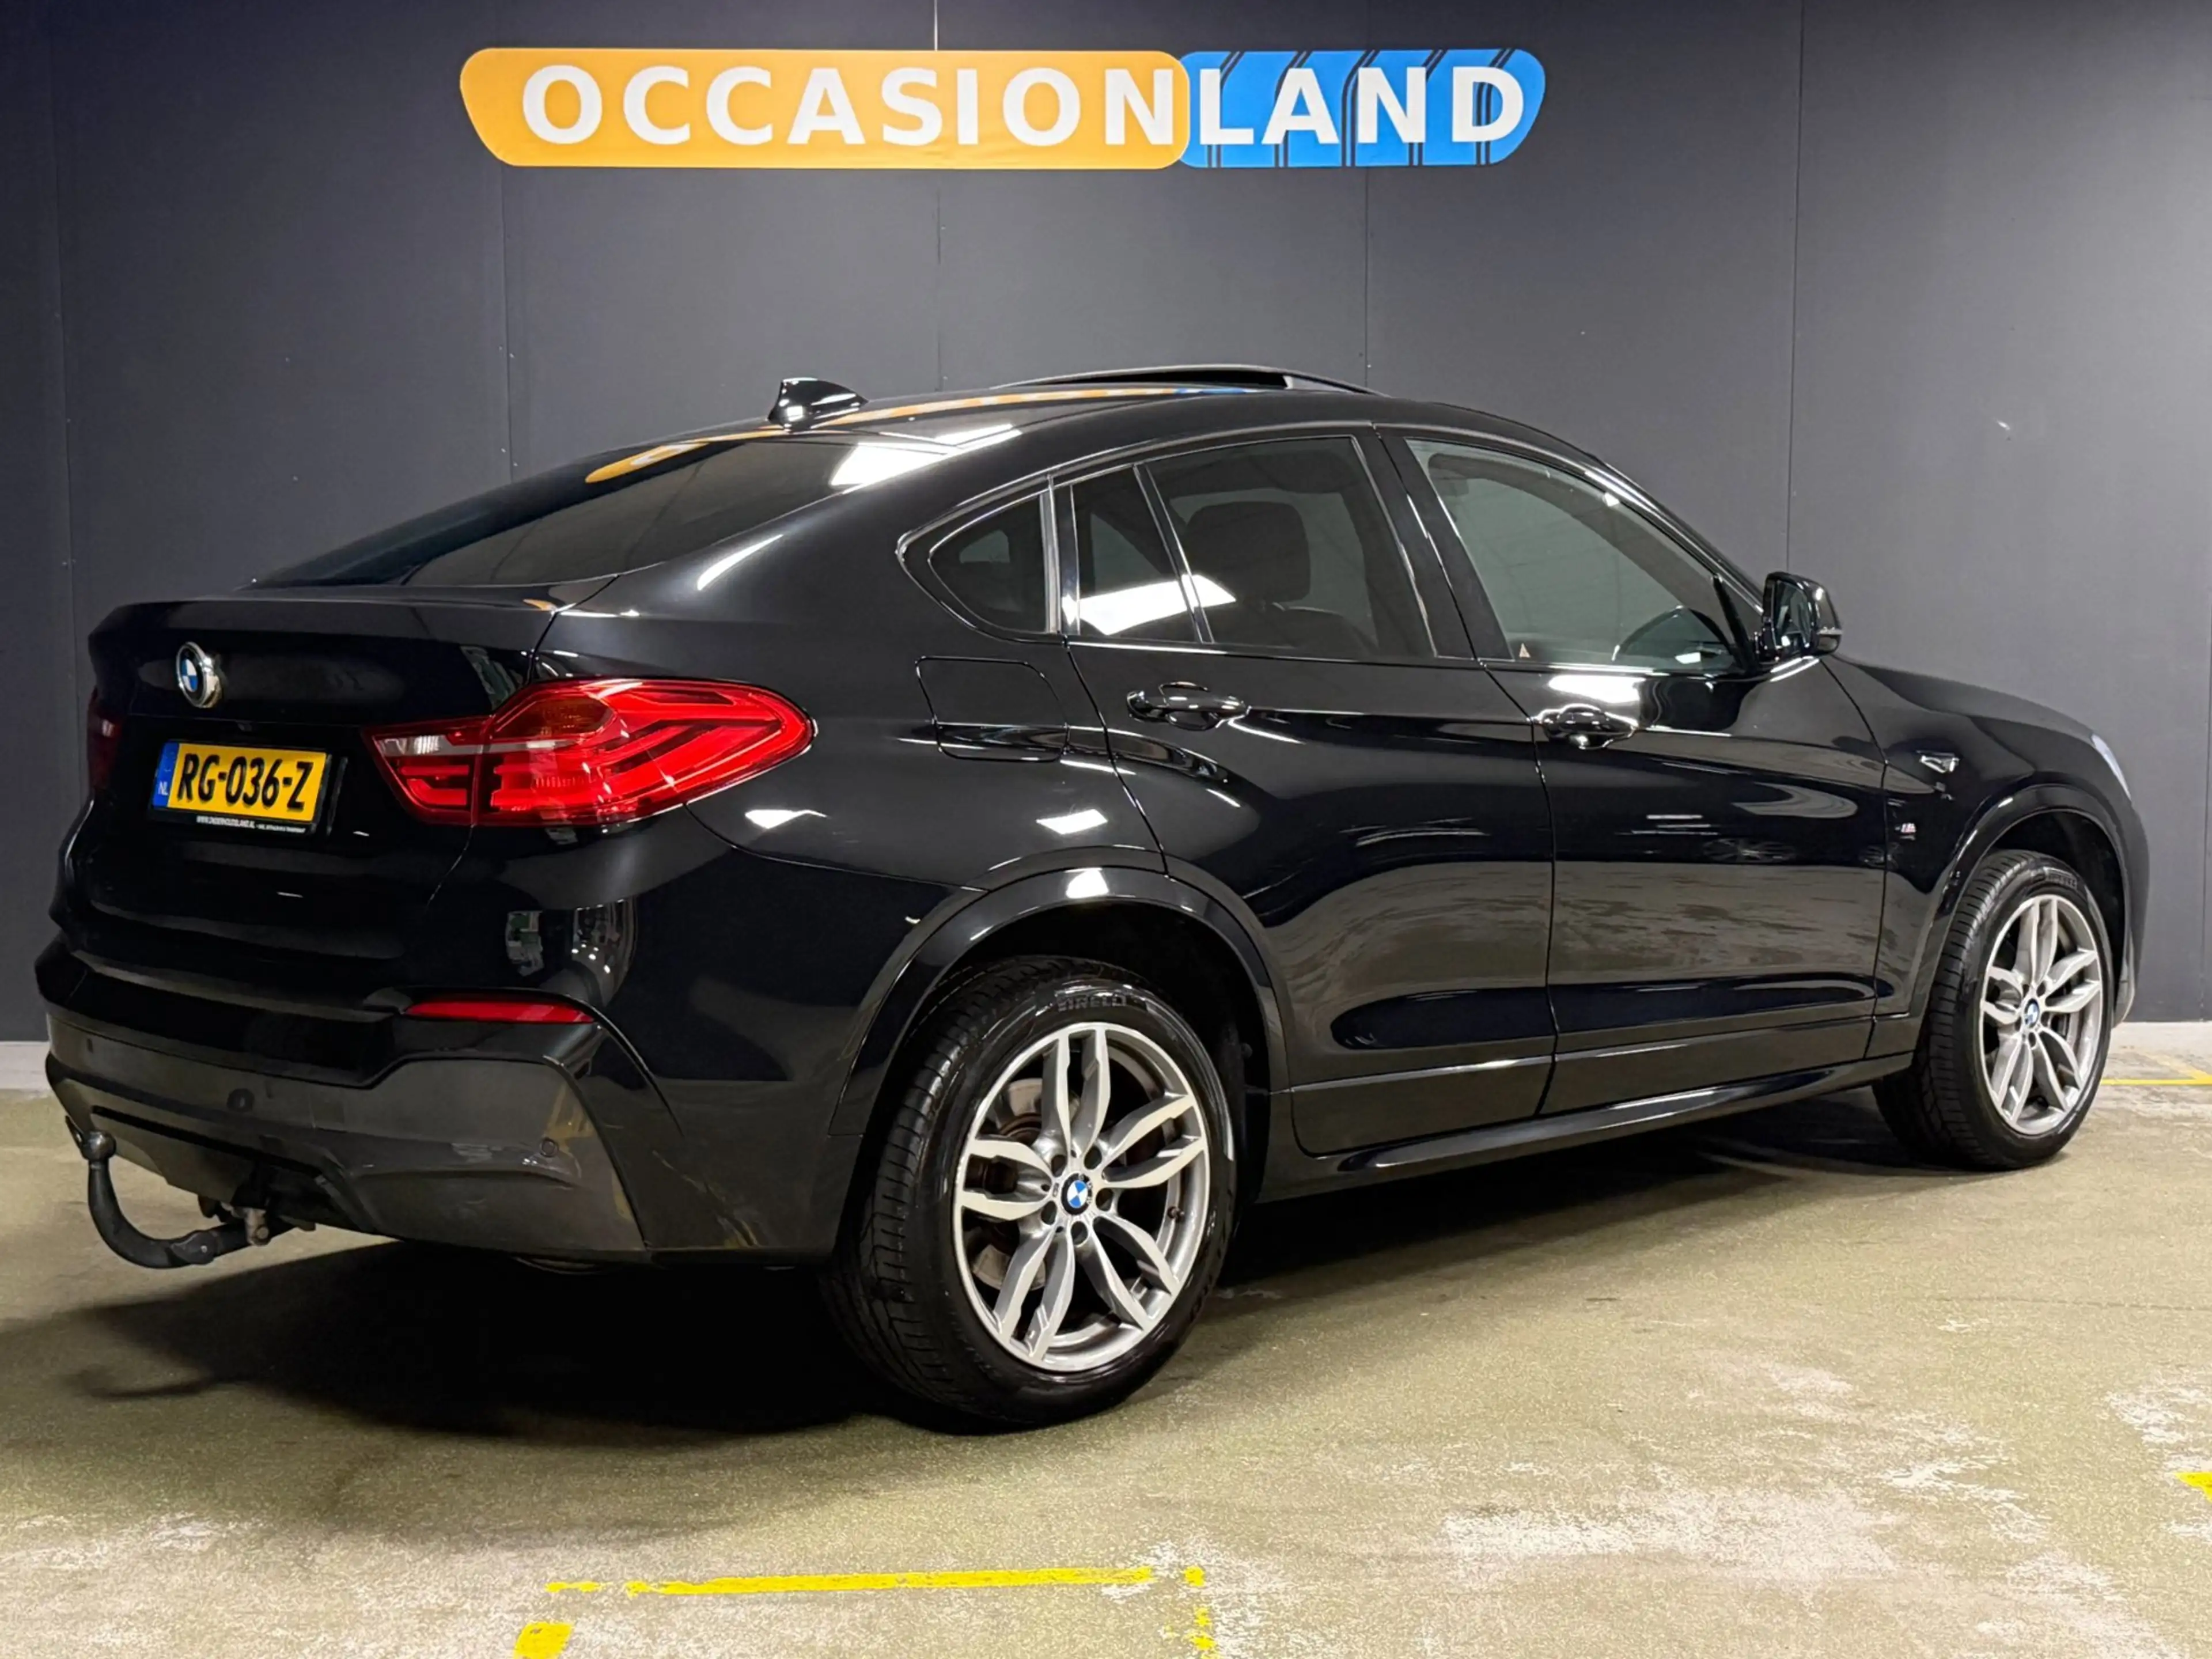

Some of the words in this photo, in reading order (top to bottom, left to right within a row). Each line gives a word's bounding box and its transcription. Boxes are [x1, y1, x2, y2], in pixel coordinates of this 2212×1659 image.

[522, 65, 1524, 145] OCCASIONLAND
[158, 781, 169, 796] NL
[177, 753, 313, 811] RG-036-Z
